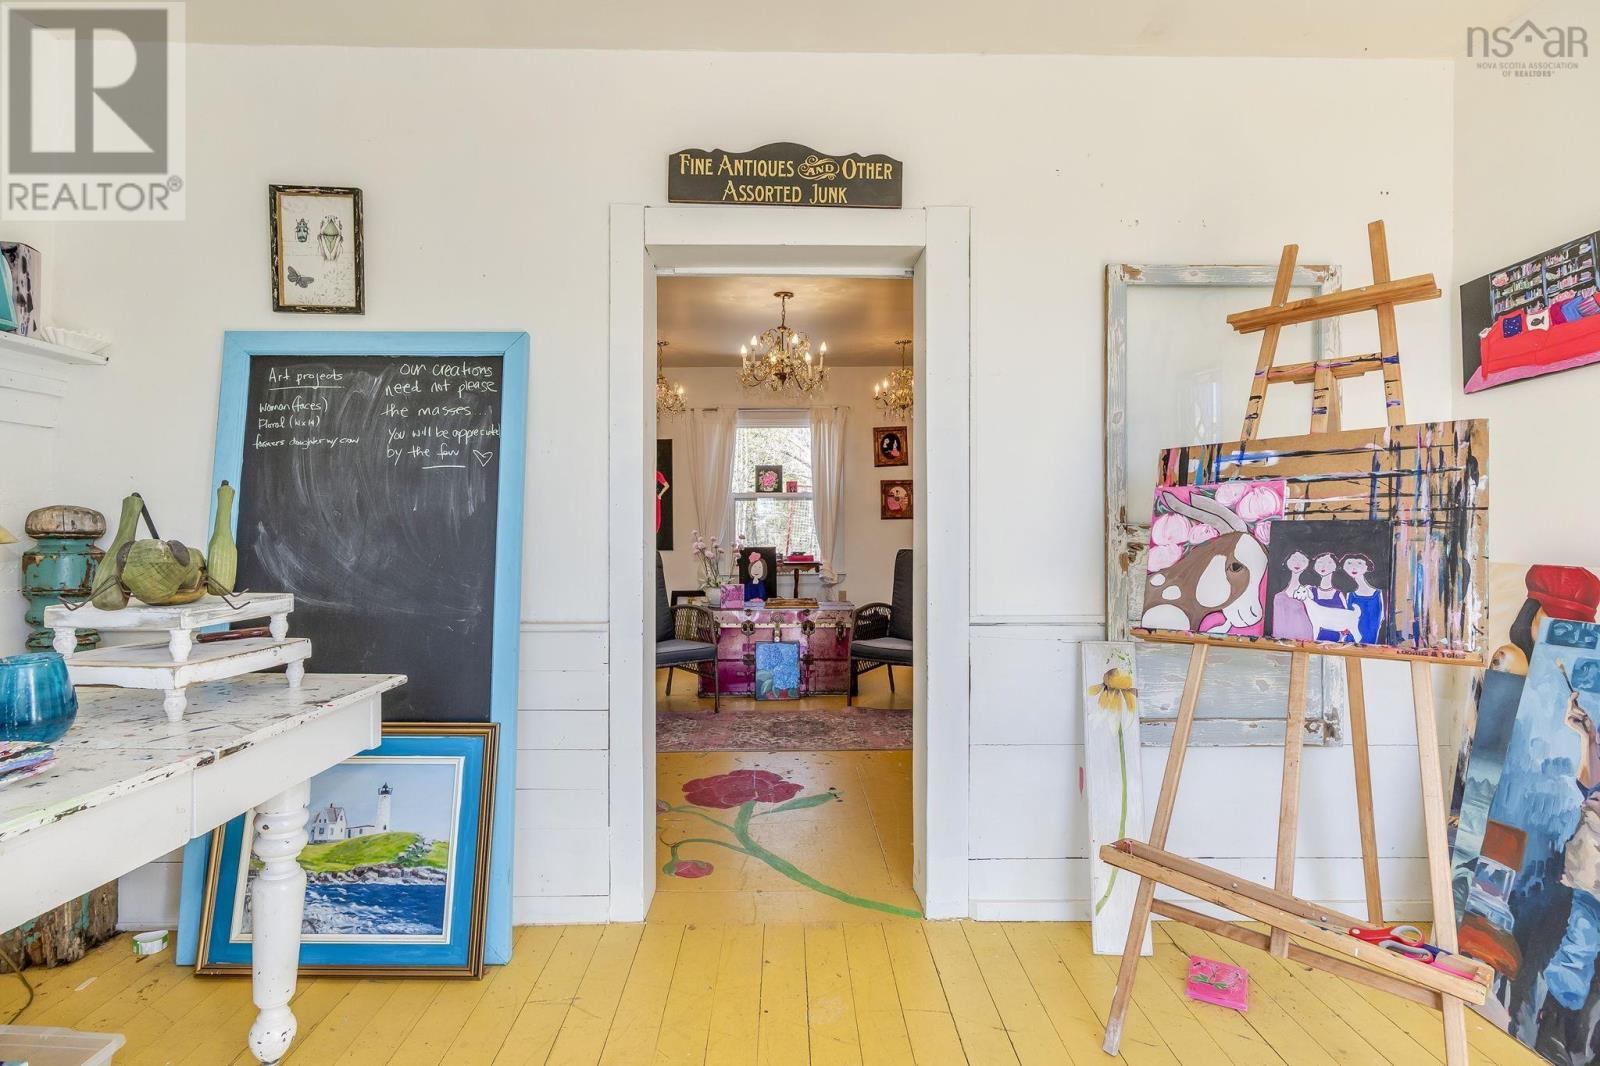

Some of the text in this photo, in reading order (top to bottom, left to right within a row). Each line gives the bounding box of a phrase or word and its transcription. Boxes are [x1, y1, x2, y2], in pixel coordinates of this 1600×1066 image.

[679, 153, 714, 176] FINE
[717, 154, 795, 179] ANTIQUES
[841, 157, 893, 180] OTHER
[722, 180, 848, 205] ASSORTED JUNK
[268, 367, 344, 390] Art projects
[385, 379, 497, 398] need not please
[380, 403, 409, 418] the
[412, 426, 431, 438] will
[435, 426, 449, 439] be
[386, 445, 403, 467] by
[407, 444, 431, 459] the
